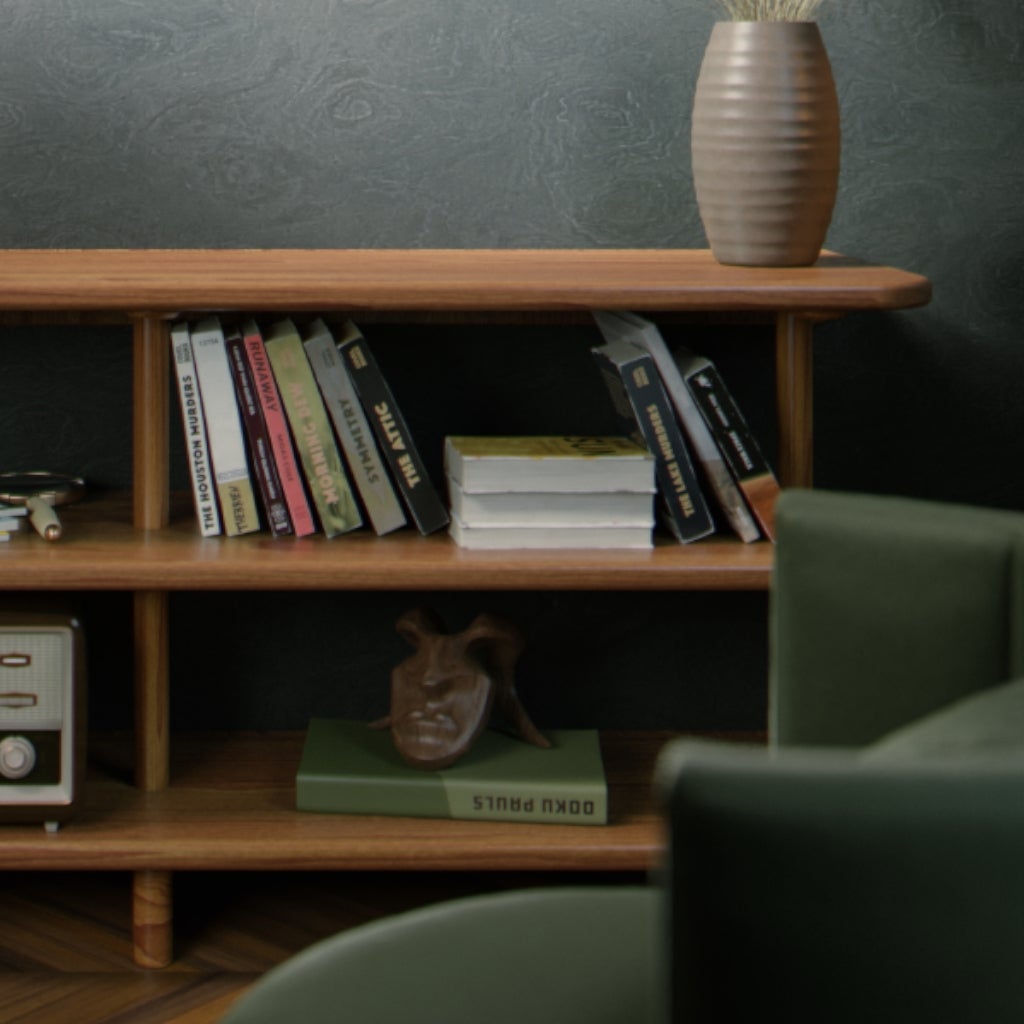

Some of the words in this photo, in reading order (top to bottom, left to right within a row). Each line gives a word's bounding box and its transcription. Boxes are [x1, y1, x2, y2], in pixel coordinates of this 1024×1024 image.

[249, 341, 278, 412] RUNAWAY
[287, 380, 312, 418] DEW
[182, 375, 200, 435] MURDERS
[372, 401, 406, 454] ATTIC
[337, 397, 380, 484] SYMMETRY
[645, 403, 676, 461] MURDERS
[191, 439, 210, 501] HOUSTON
[299, 421, 340, 505] MORNING
[396, 452, 422, 489] THE
[666, 461, 686, 493] LAKE
[201, 506, 214, 529] THE
[678, 493, 695, 518] THE
[473, 795, 534, 812] PAULS
[542, 799, 594, 815] DOKU
